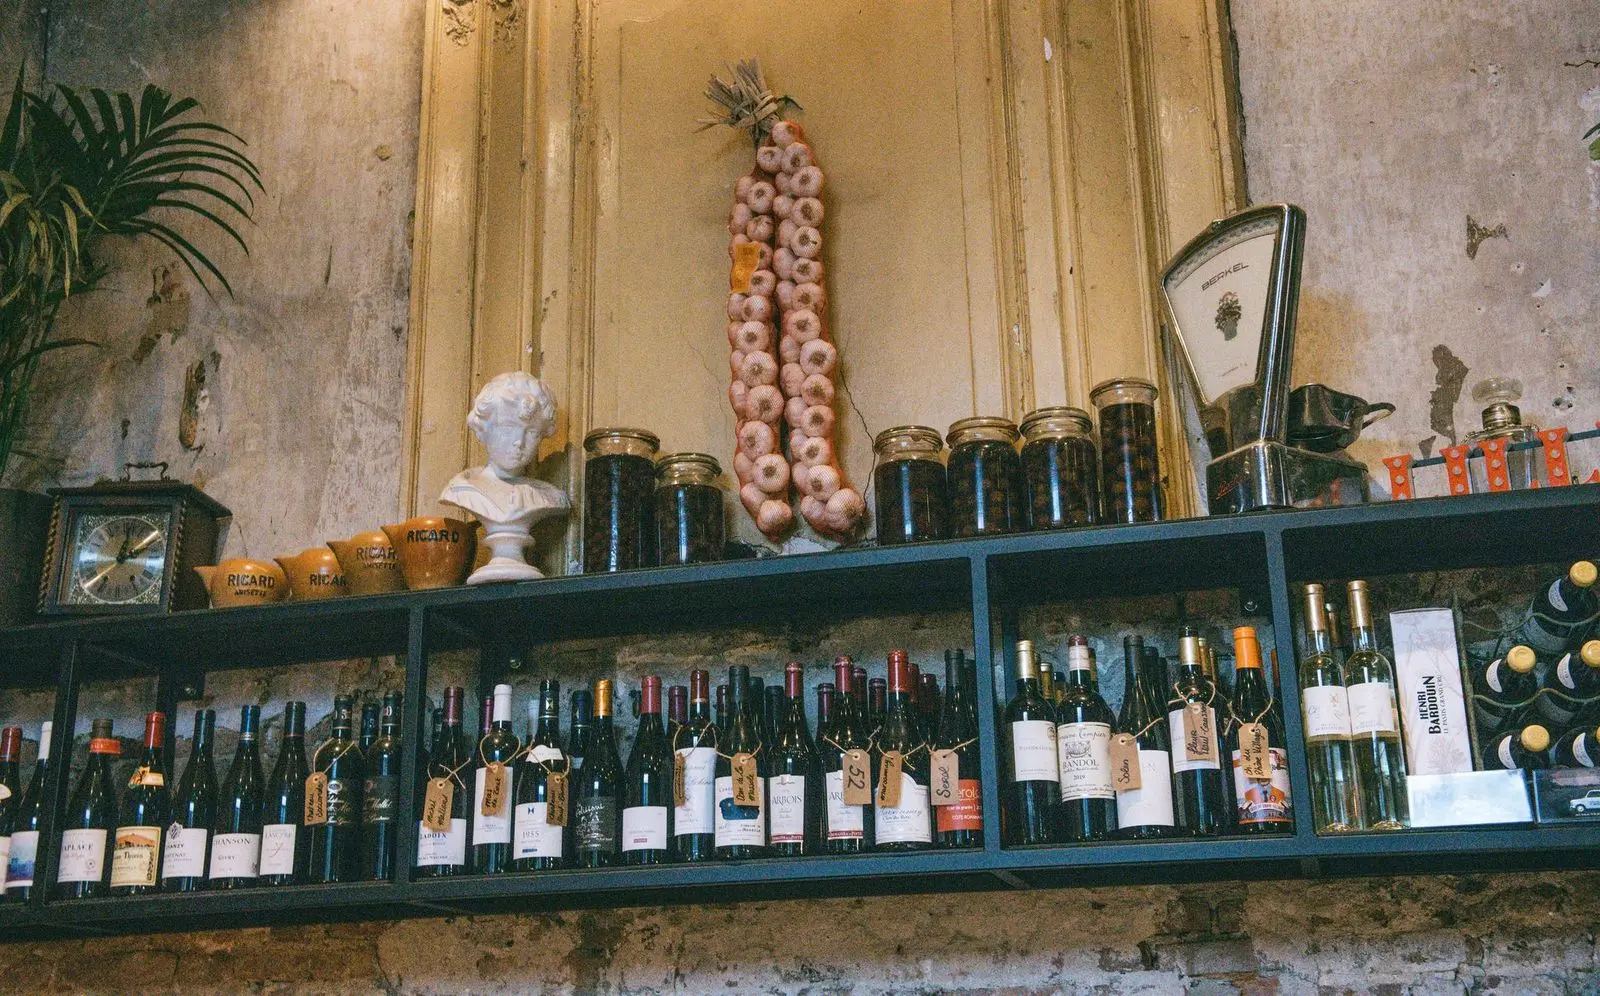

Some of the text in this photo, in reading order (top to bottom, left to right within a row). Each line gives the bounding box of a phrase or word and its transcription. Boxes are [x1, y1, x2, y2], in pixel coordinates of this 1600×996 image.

[1201, 262, 1249, 291] BERKEL
[406, 529, 460, 543] RICARD
[356, 545, 399, 560] RICAR
[227, 573, 276, 589] RICARD
[1417, 691, 1429, 720] HENRI
[1421, 676, 1442, 734] BARDOUIN
[848, 764, 865, 790] 52
[772, 795, 802, 806] ARBOIS
